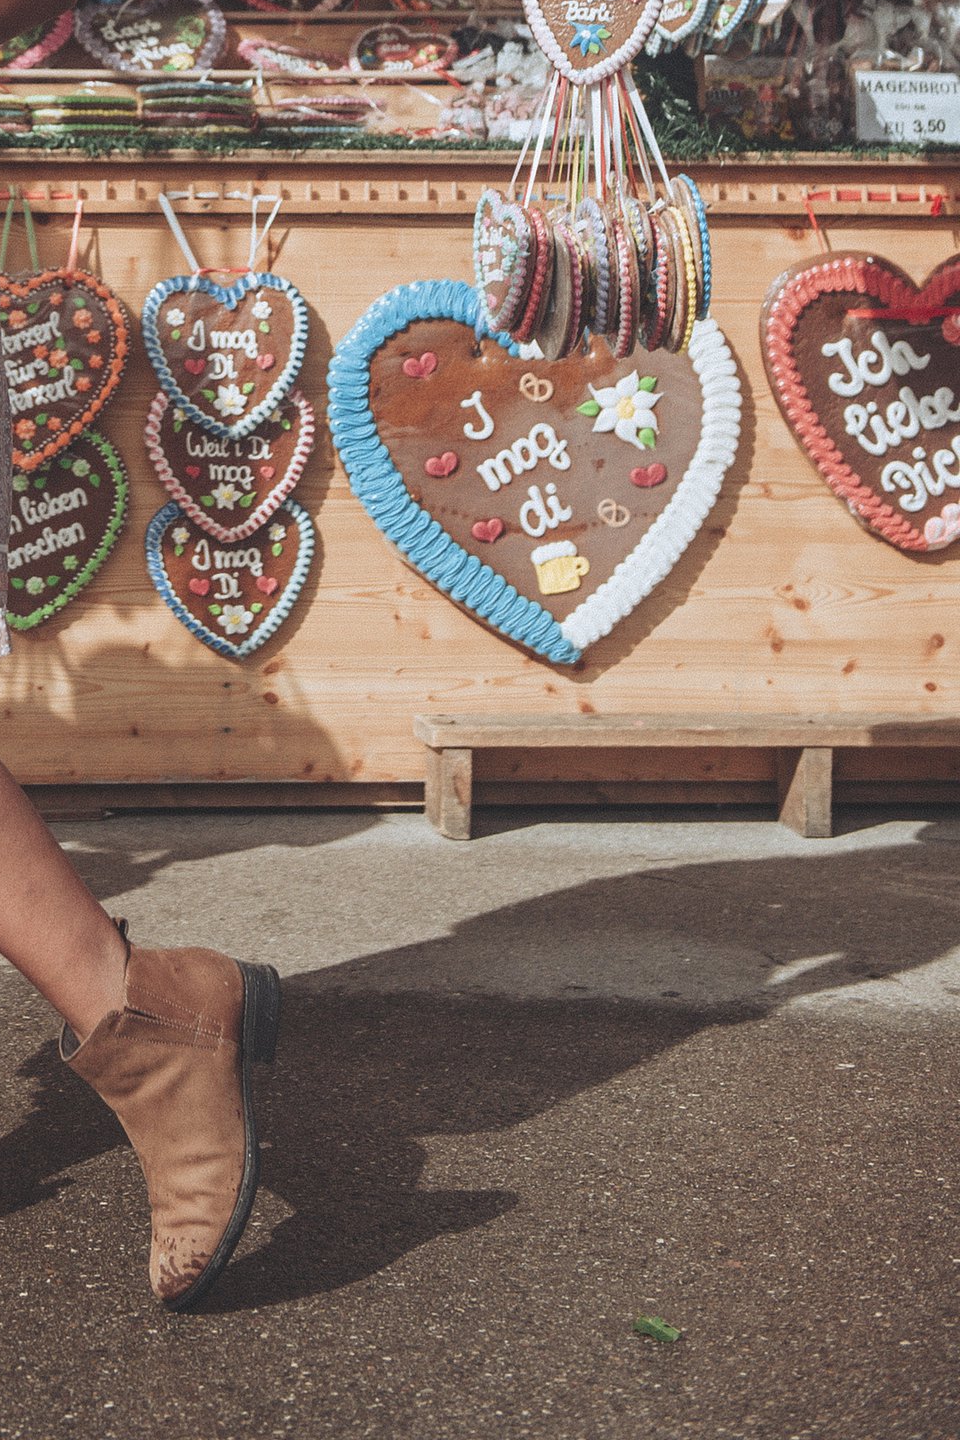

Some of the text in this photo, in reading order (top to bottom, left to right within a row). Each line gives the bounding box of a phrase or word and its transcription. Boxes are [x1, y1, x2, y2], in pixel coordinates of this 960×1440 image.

[859, 80, 958, 95] MAGENBROT
[209, 328, 259, 360] mog
[186, 431, 231, 458] Weil
[247, 435, 274, 460] Di
[475, 422, 572, 492] mog
[208, 462, 256, 491] mog
[881, 434, 960, 512] Dic
[20, 487, 87, 525] lieben
[519, 482, 573, 538] di
[7, 522, 86, 570] enschen
[213, 547, 264, 577] mog
[211, 571, 243, 600] Di
